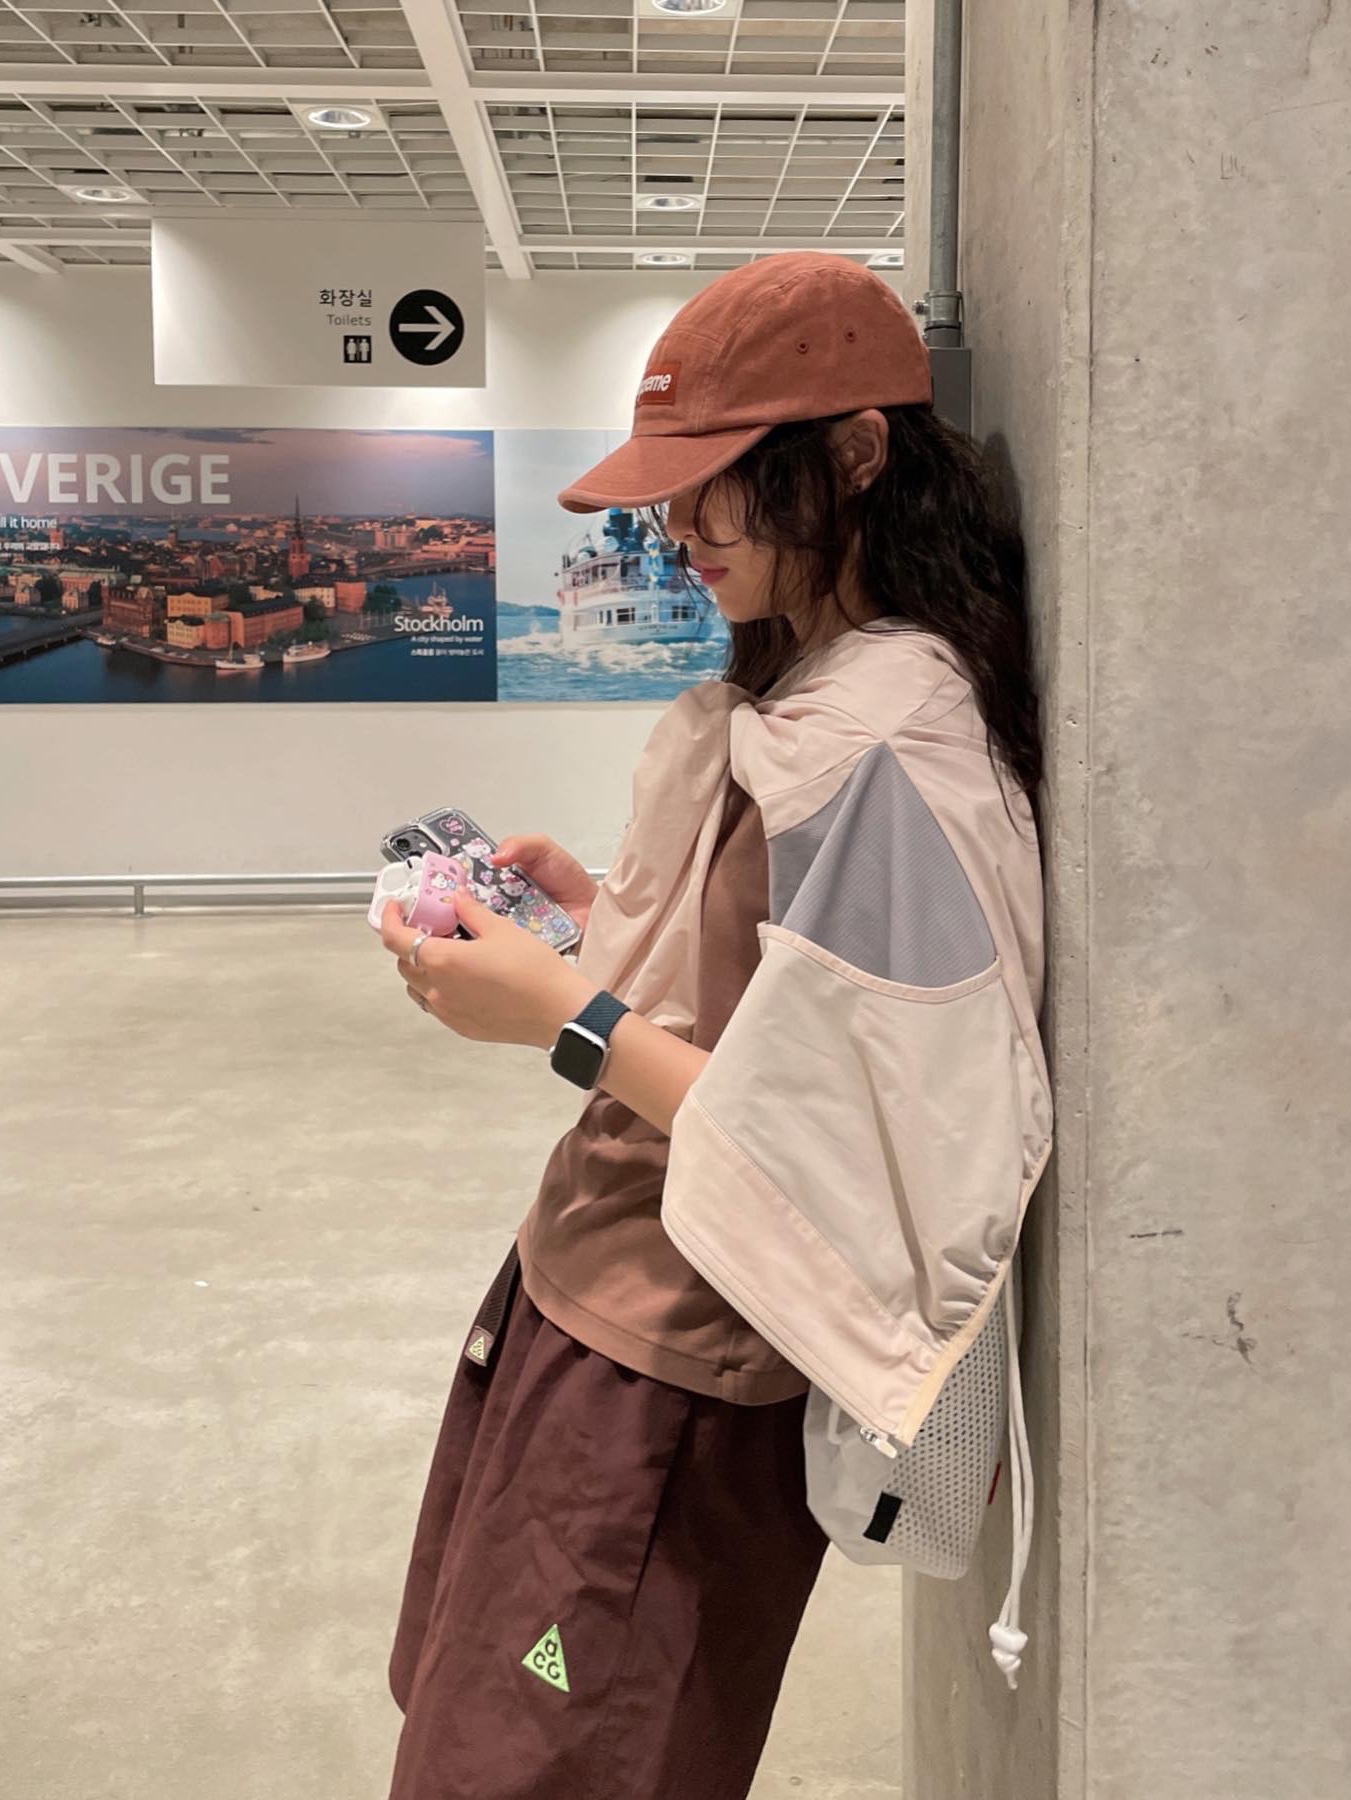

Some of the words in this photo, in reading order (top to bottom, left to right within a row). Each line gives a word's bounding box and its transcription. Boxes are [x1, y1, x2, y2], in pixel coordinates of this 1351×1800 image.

[319, 289, 372, 307] 화장실
[327, 314, 371, 326] Toilets
[0, 453, 231, 505] VERIGE
[9, 516, 18, 528] it
[21, 516, 57, 528] home
[394, 614, 484, 632] Stockholm
